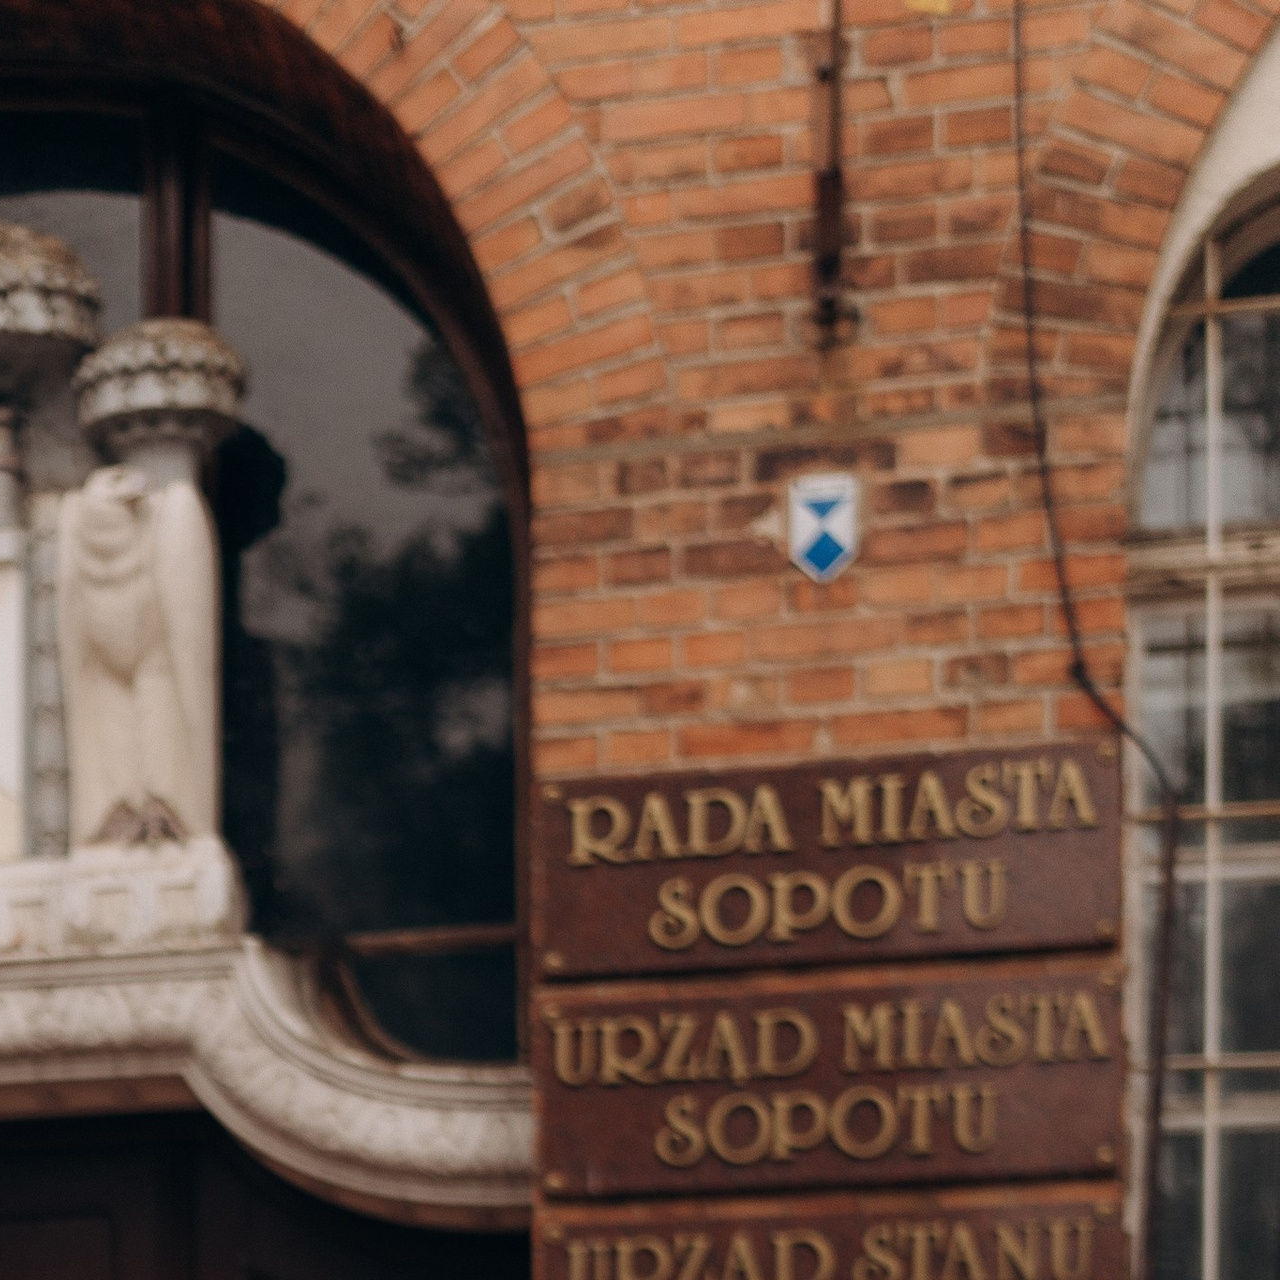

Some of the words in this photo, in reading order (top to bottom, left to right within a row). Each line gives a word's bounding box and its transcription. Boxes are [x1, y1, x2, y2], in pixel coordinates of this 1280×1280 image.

[566, 784, 795, 867] RADA
[819, 756, 1099, 849] MIASTA
[647, 857, 1010, 950] SOPOTU
[841, 989, 1111, 1074] MIASTA
[652, 1083, 1000, 1169] SOPOTU
